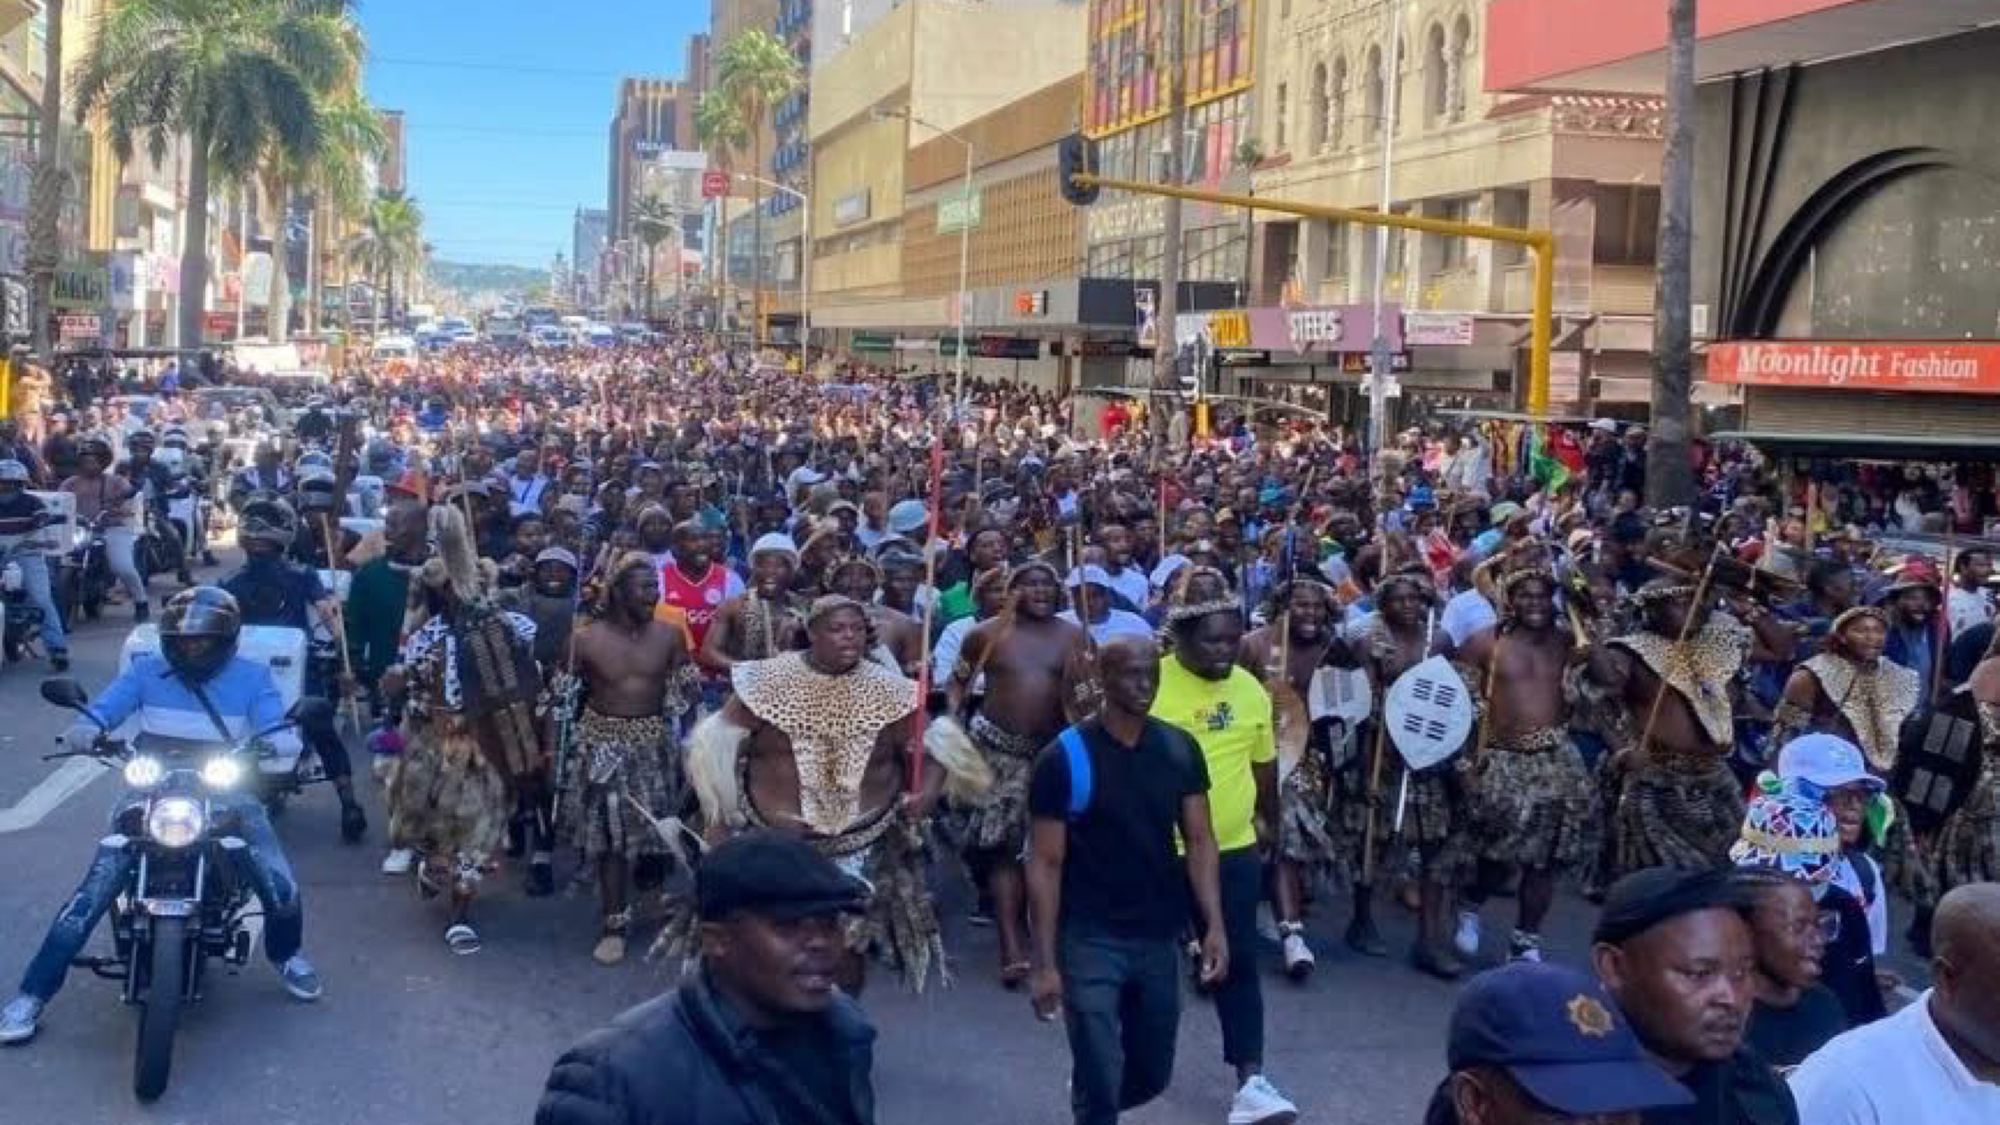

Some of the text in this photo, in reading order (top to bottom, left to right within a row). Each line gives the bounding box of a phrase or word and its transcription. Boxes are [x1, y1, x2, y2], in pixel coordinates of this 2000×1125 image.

[1291, 310, 1343, 342] STEERS
[1737, 345, 1978, 383] Moonlight Fashion
